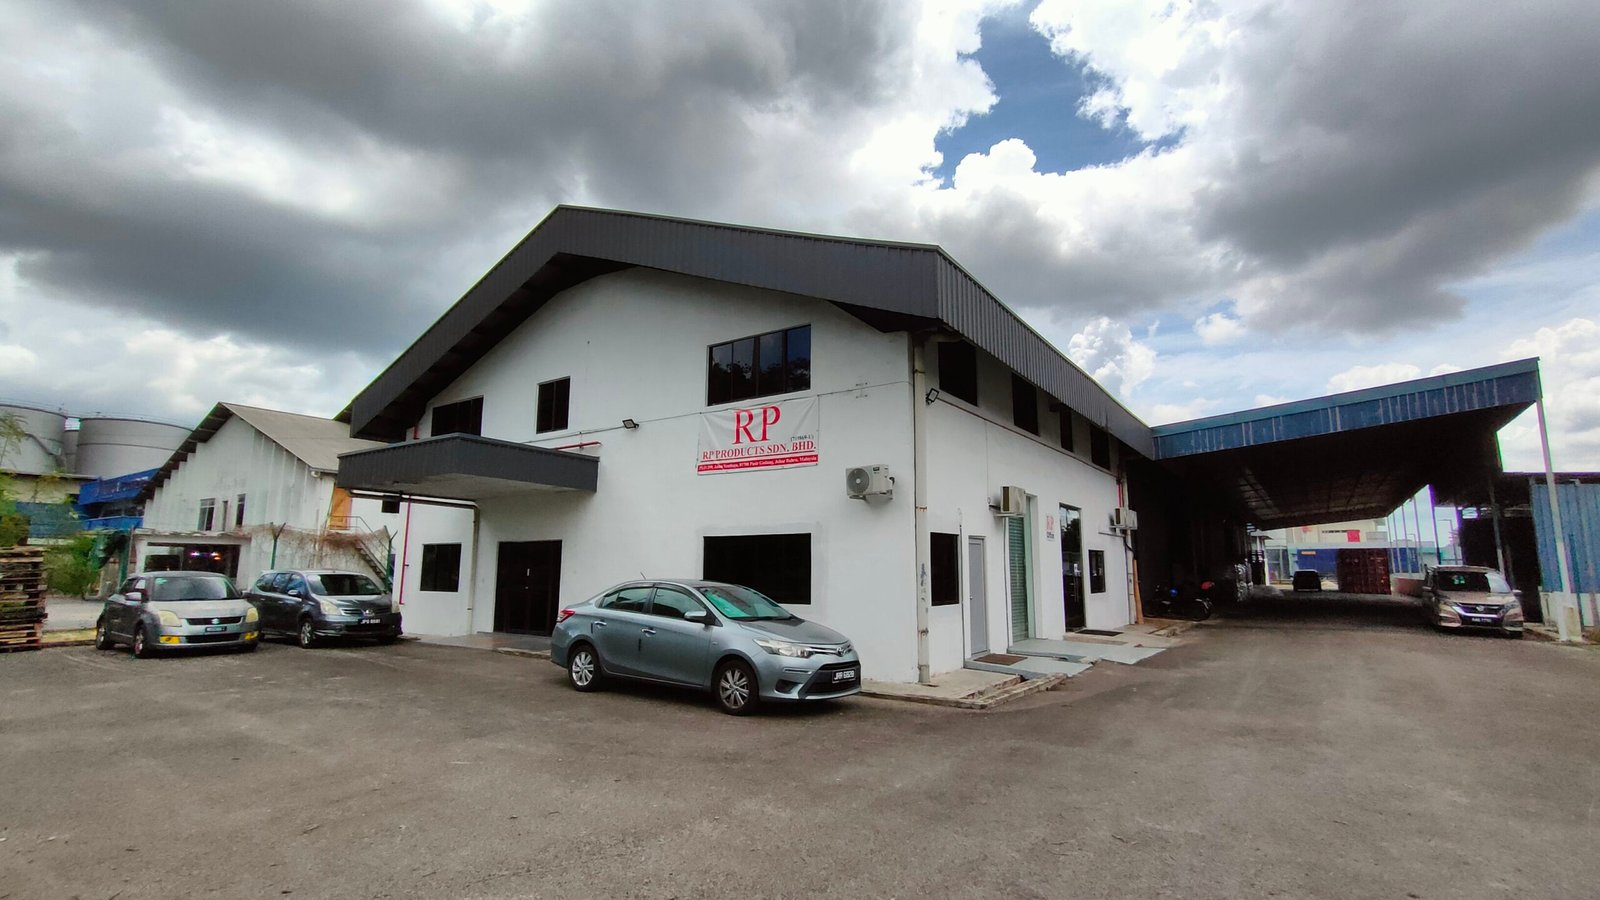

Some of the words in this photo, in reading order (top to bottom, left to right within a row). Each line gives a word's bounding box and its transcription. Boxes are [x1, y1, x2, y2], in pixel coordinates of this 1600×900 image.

[732, 404, 781, 445] RP
[703, 450, 714, 460] RP
[715, 446, 765, 459] PRODUCTS
[767, 444, 789, 454] SDN.
[792, 440, 816, 451] BHD.
